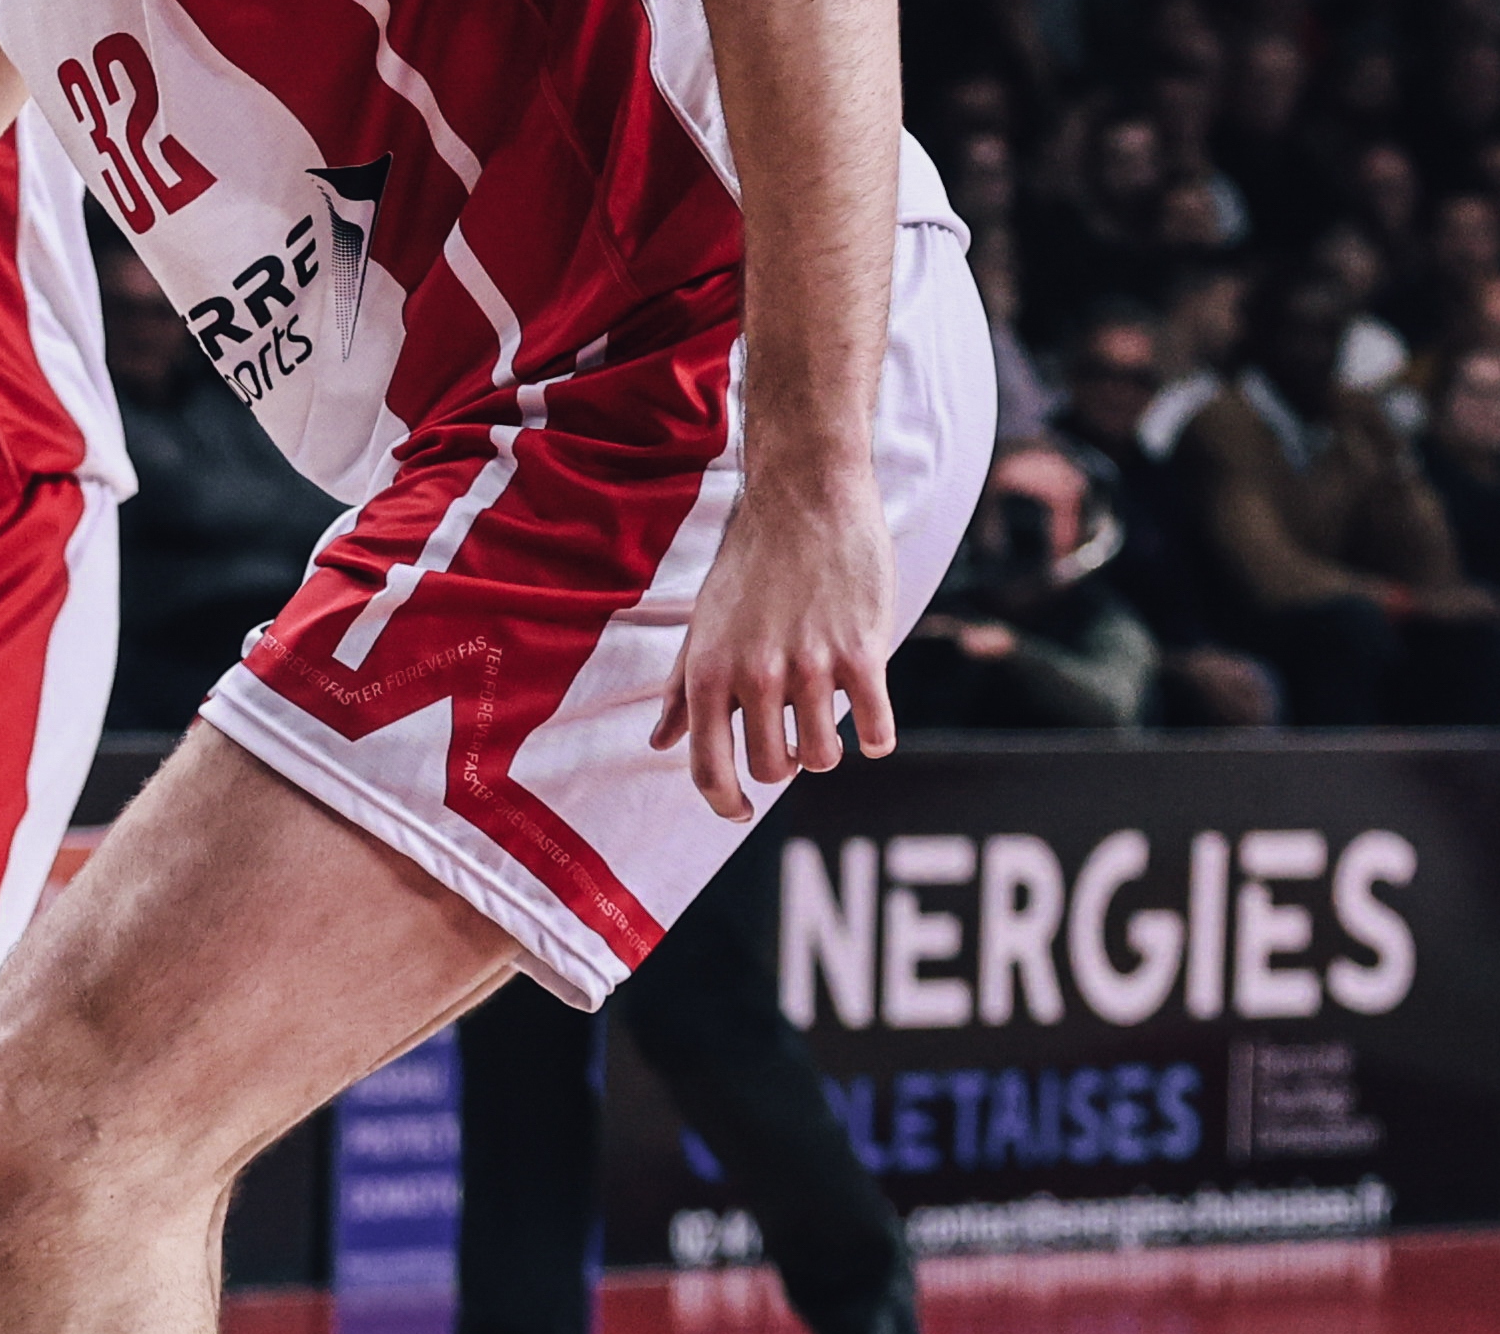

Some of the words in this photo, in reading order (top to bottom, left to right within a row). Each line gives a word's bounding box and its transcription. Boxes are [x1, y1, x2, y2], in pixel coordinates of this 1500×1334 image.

[58, 32, 217, 235] 32
[181, 214, 319, 362] RRE
[325, 680, 383, 706] FASTER
[462, 751, 494, 803] FASTER
[592, 891, 630, 933] FASTER
[778, 828, 1418, 1029] NERGIES
